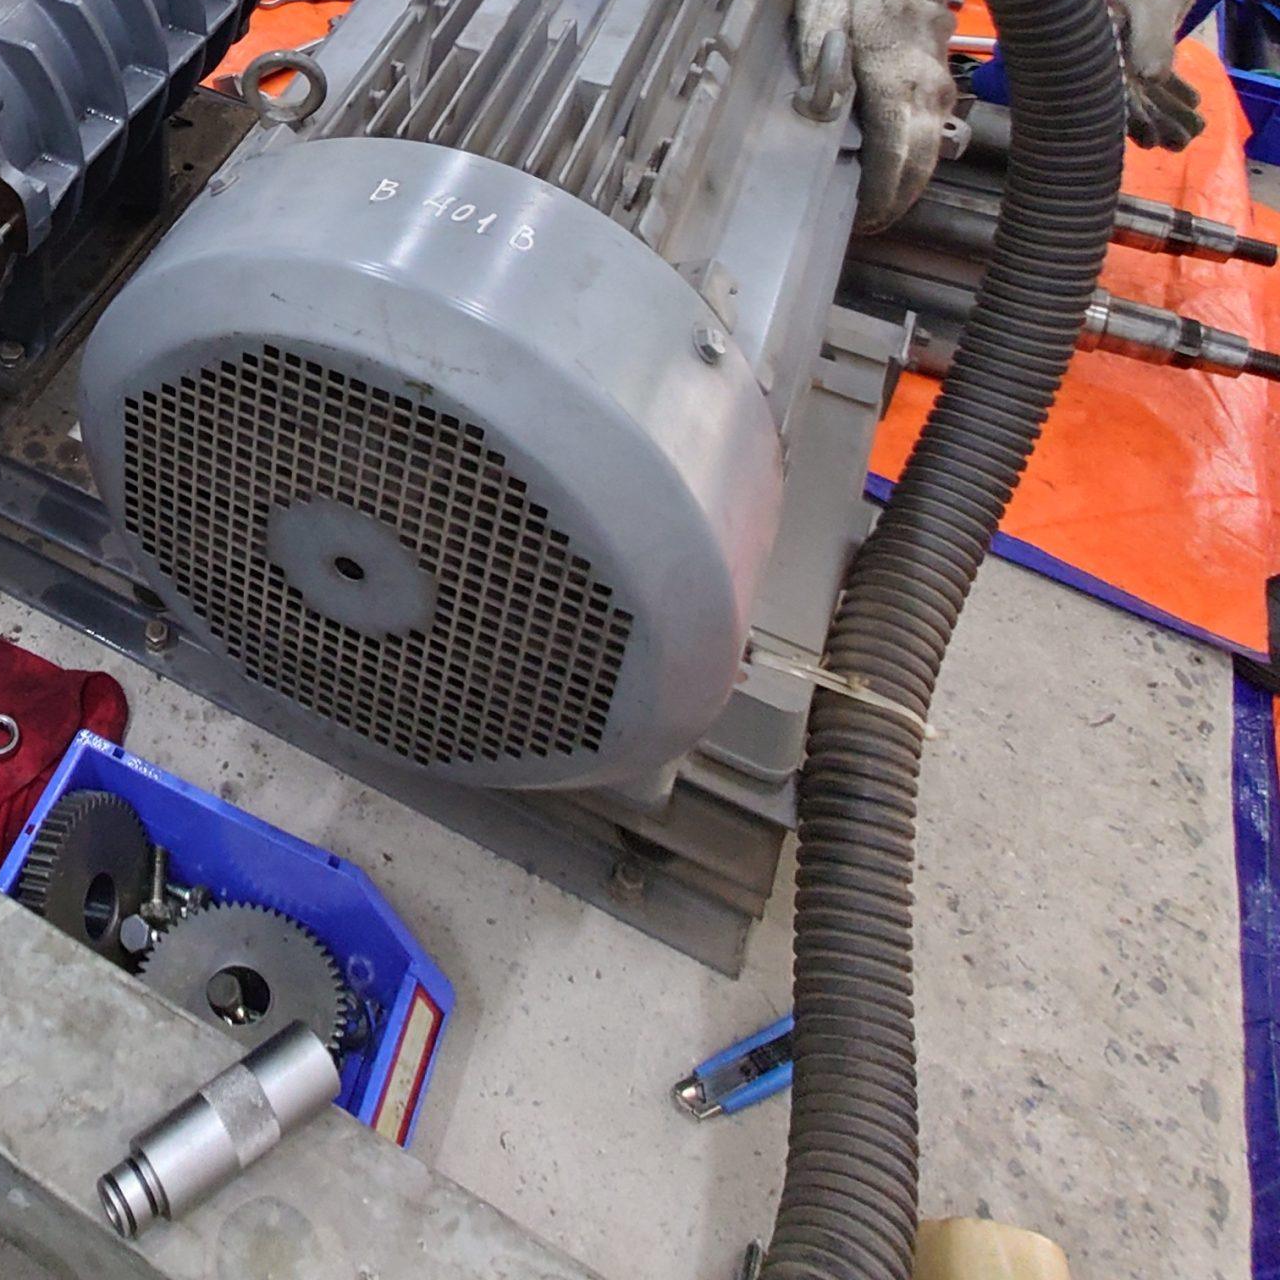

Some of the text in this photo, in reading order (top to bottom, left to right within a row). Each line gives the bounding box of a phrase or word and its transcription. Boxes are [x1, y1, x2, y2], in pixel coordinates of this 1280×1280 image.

[370, 178, 535, 250] B 401 B
